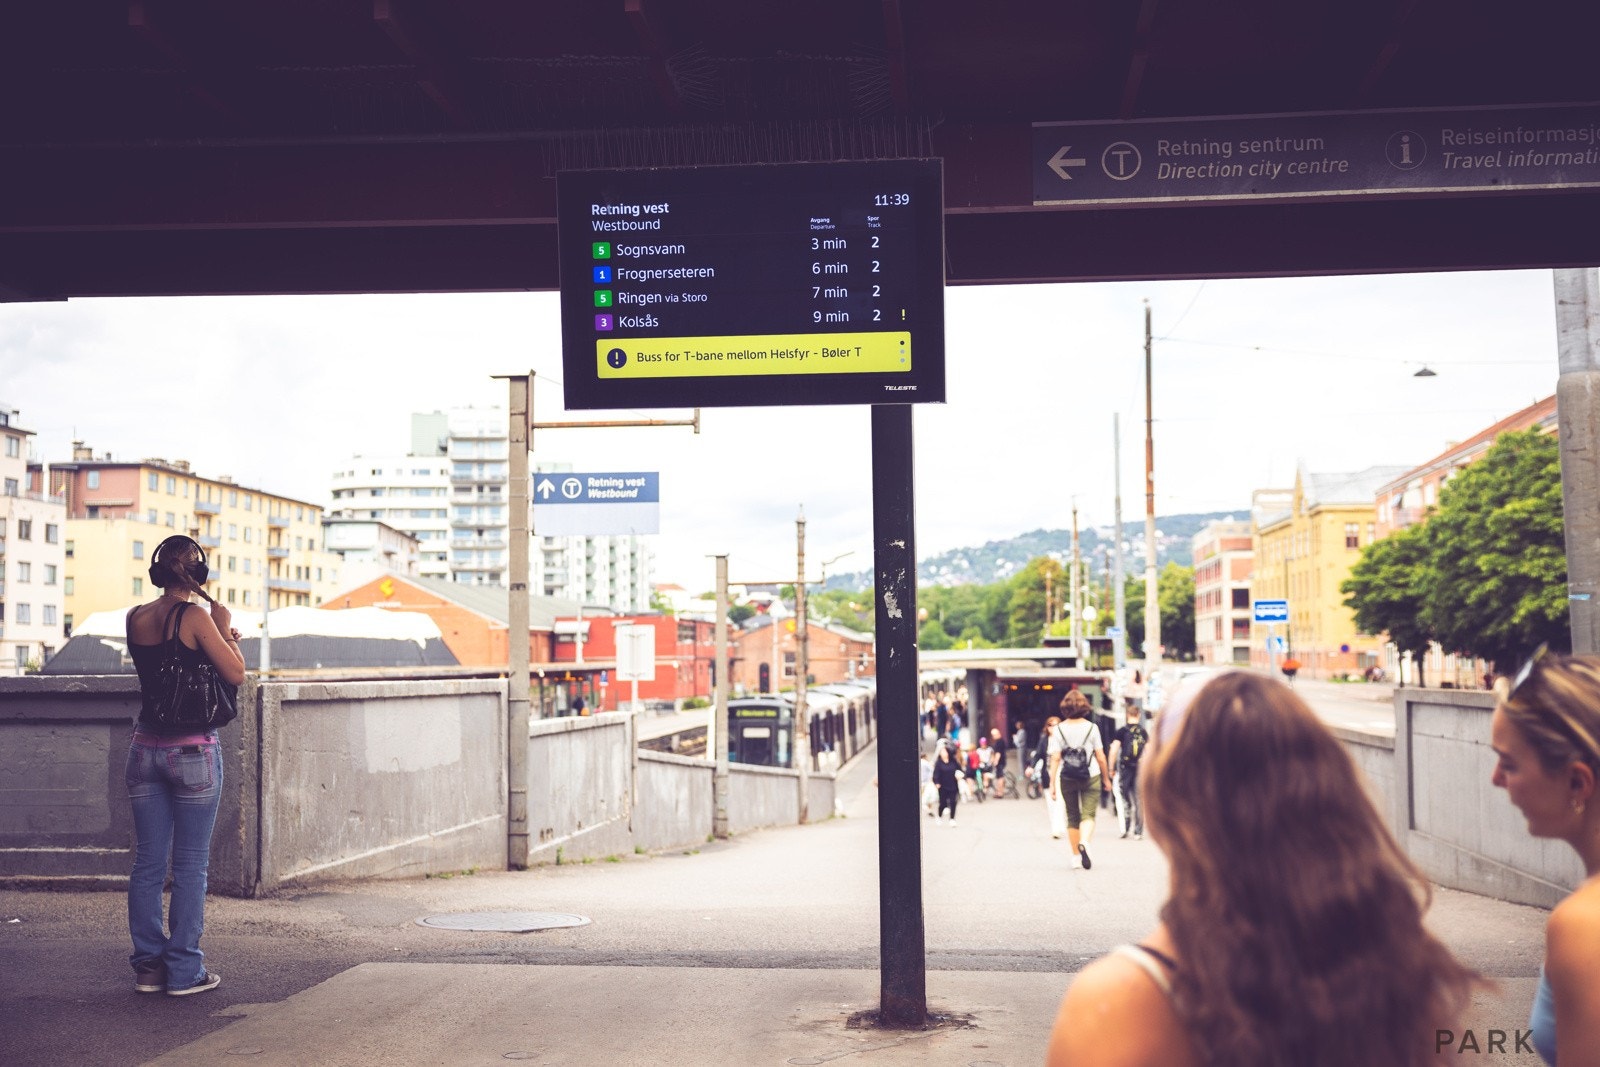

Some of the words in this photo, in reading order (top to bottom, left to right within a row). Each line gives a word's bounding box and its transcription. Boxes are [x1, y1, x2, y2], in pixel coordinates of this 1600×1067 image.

[1157, 139, 1232, 158] Retning
[1239, 136, 1324, 154] sentrum
[1442, 150, 1501, 169] Travel
[1507, 146, 1600, 167] informati
[1157, 161, 1242, 180] Direction
[1248, 158, 1283, 180] city
[1287, 158, 1350, 175] centre
[874, 194, 910, 206] 11:39
[591, 203, 640, 216] Retning
[642, 202, 670, 214] vest
[592, 218, 661, 232] Westbound
[811, 238, 819, 250] 3
[823, 238, 846, 250] min
[871, 236, 880, 248] 2
[598, 246, 605, 255] 5
[616, 244, 686, 258] Sognsvann
[812, 262, 820, 274] 6
[824, 262, 848, 274] min
[872, 260, 880, 272] 2
[600, 270, 606, 280] 1
[618, 268, 714, 282] Frognerseteren
[812, 286, 820, 298] 7
[824, 286, 848, 298] min
[872, 285, 880, 296] 2
[600, 294, 606, 303] 5
[618, 292, 662, 306] Ringen
[664, 294, 679, 302] via
[682, 293, 708, 302] Storo
[600, 318, 607, 327] 3
[619, 314, 658, 328] Kolsås
[813, 310, 822, 322] 9
[826, 310, 850, 322] min
[872, 310, 880, 321] 2
[637, 352, 662, 362] Buss
[665, 352, 680, 362] for
[684, 351, 724, 360] T-bane
[726, 350, 766, 360] mellom
[770, 348, 810, 360] Helsfyr
[822, 348, 850, 358] Bøler
[854, 347, 862, 356] T
[588, 477, 624, 489] Retning
[626, 478, 646, 486] vest
[588, 488, 638, 498] Westbound
